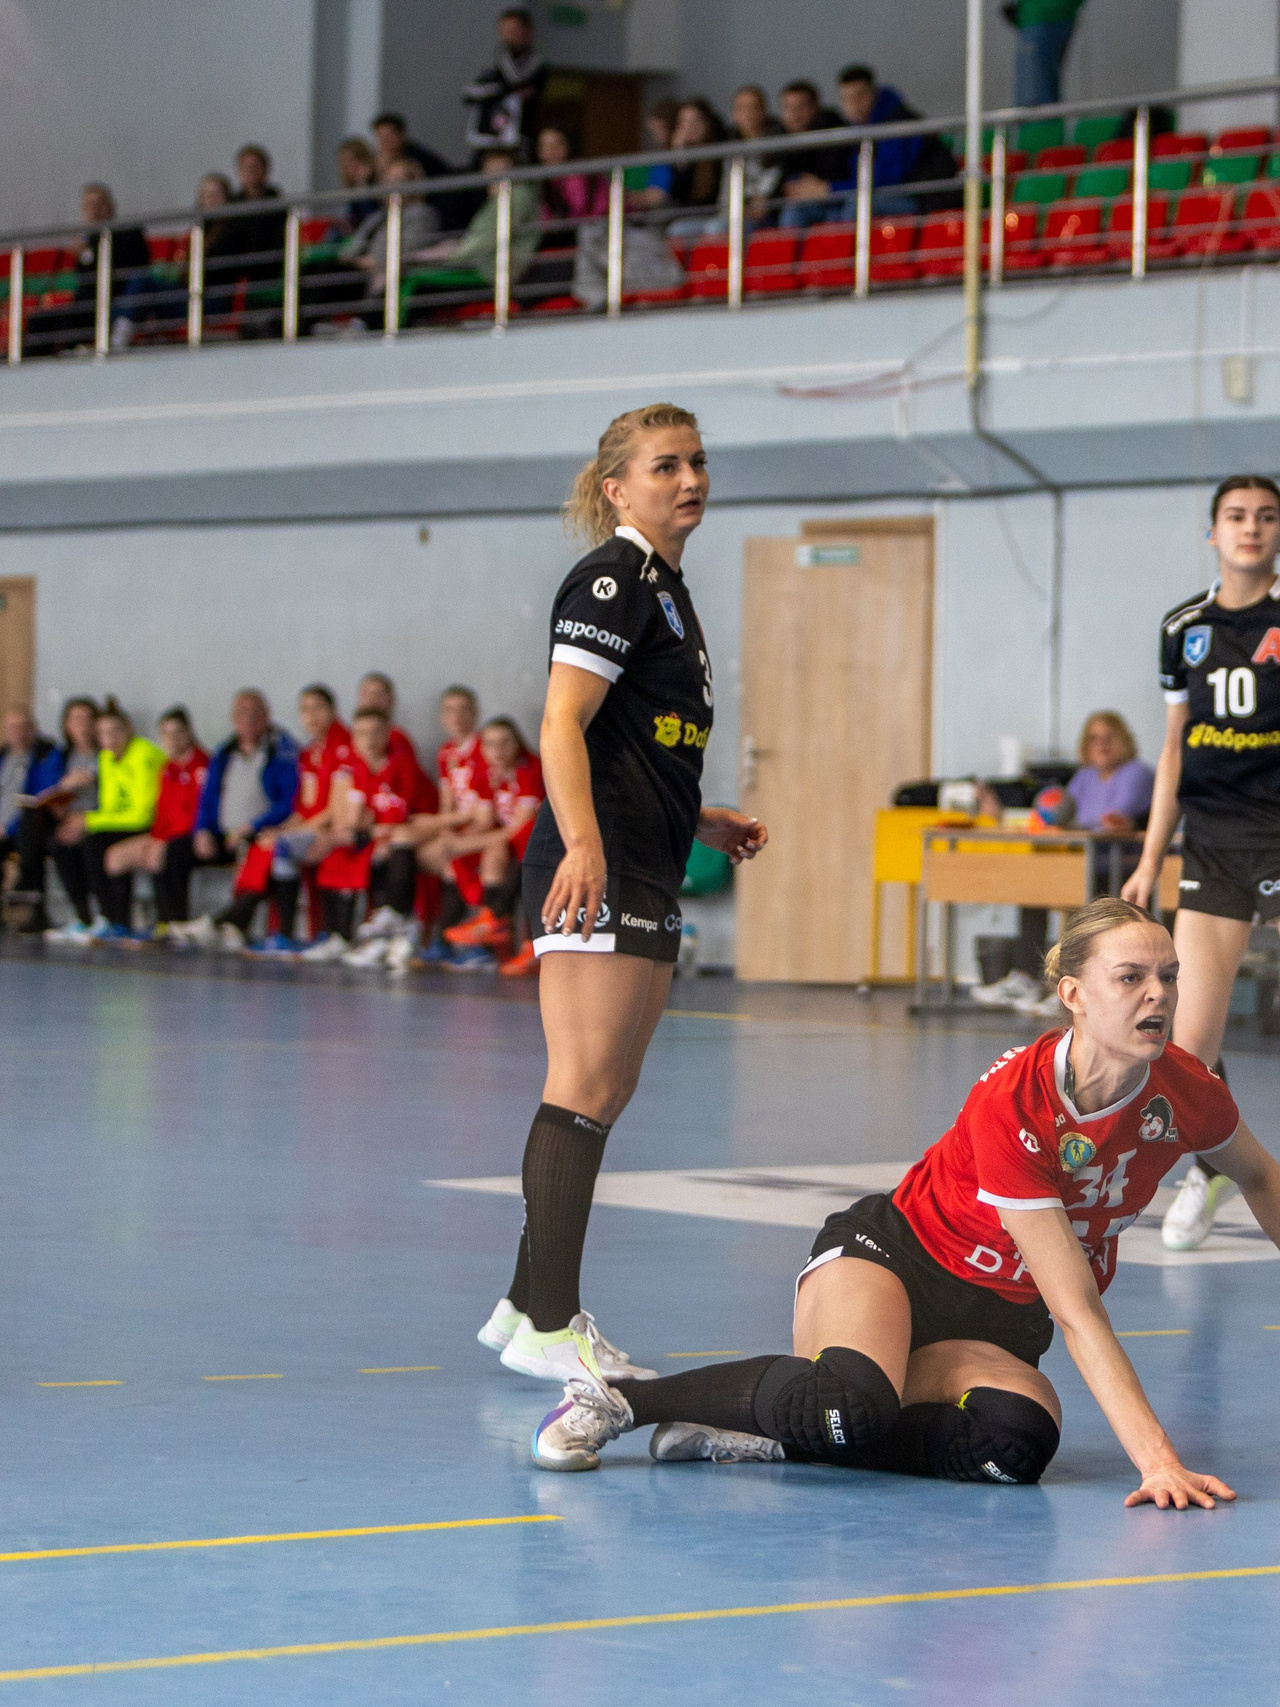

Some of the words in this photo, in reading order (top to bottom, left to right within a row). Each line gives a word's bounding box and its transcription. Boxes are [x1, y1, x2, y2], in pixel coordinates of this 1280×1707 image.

[1207, 667, 1256, 718] 10
[620, 912, 658, 932] Kempa
[1065, 1149, 1138, 1210] 34
[829, 1409, 846, 1444] SELECT
